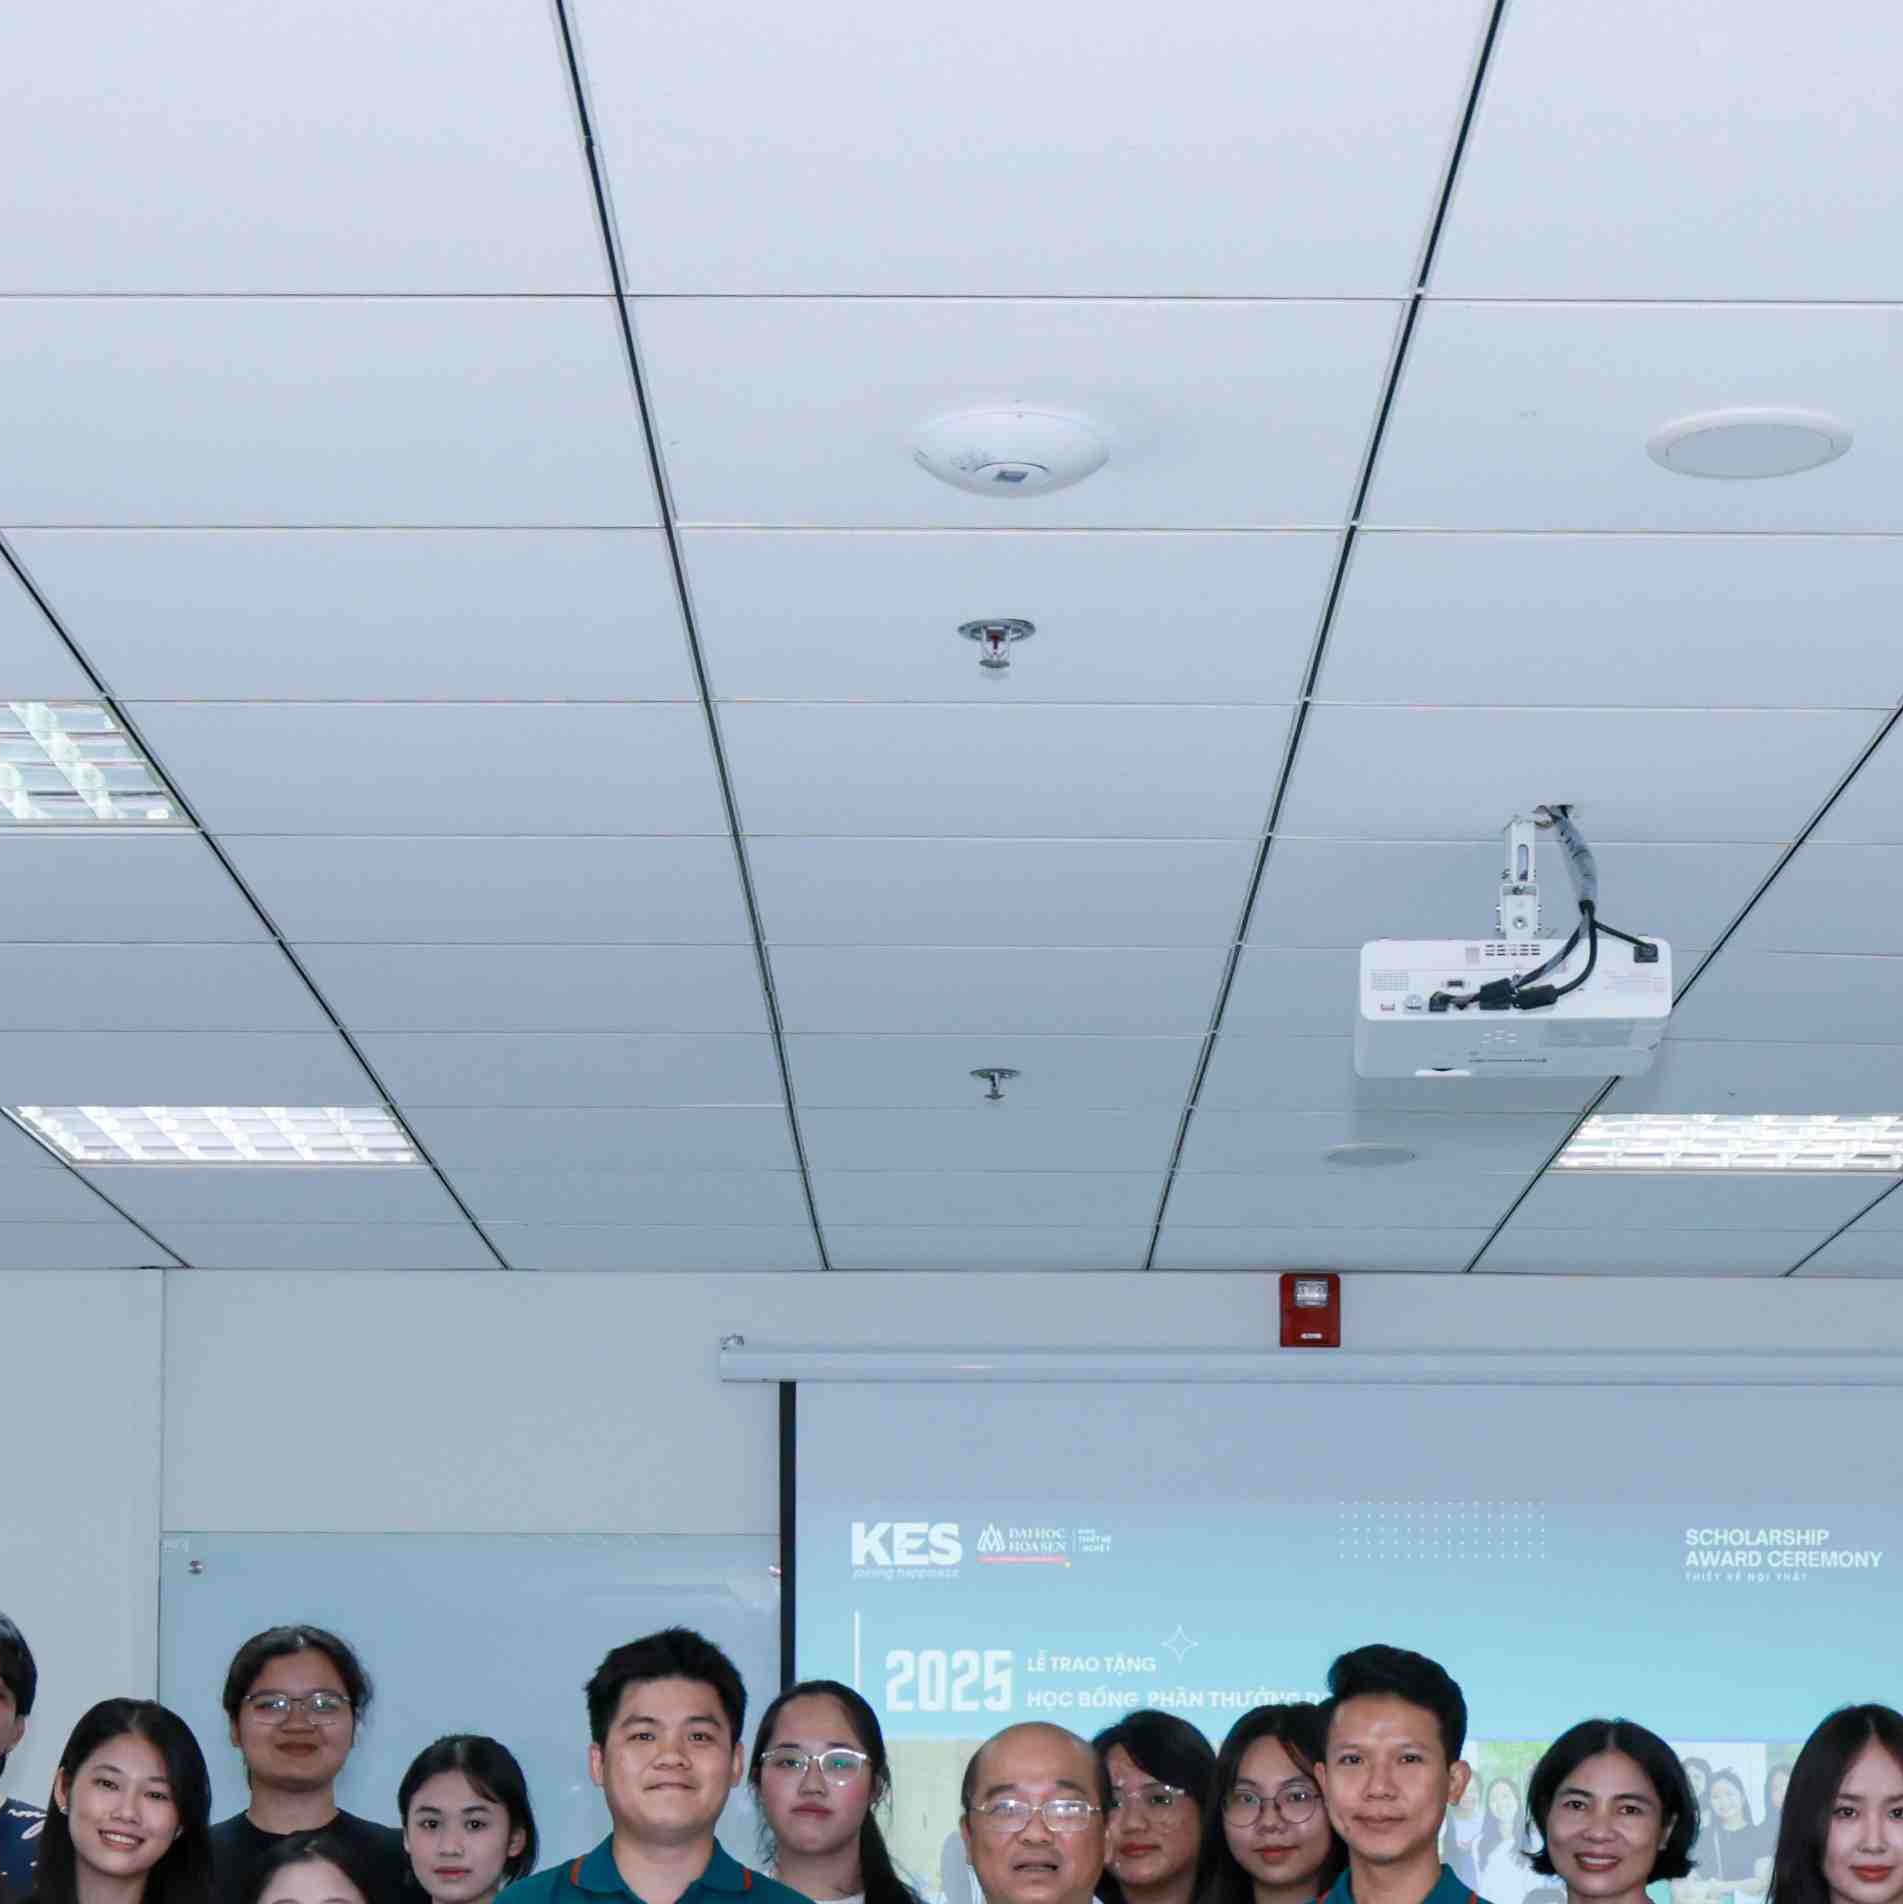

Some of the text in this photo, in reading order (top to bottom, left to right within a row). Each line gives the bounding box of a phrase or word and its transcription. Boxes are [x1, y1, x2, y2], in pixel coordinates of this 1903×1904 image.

[851, 1522, 962, 1566] KES
[1686, 1528, 1829, 1545] SCHOLARSHIP
[1686, 1551, 1883, 1567] AWARD CEREMONY
[1027, 1650, 1157, 1676] LỄ TRAO TẶNG
[885, 1649, 1015, 1712] 2025
[1027, 1690, 1073, 1711] HỌC
[1078, 1685, 1137, 1707] BỔNG
[1146, 1686, 1203, 1708] PHẦN
